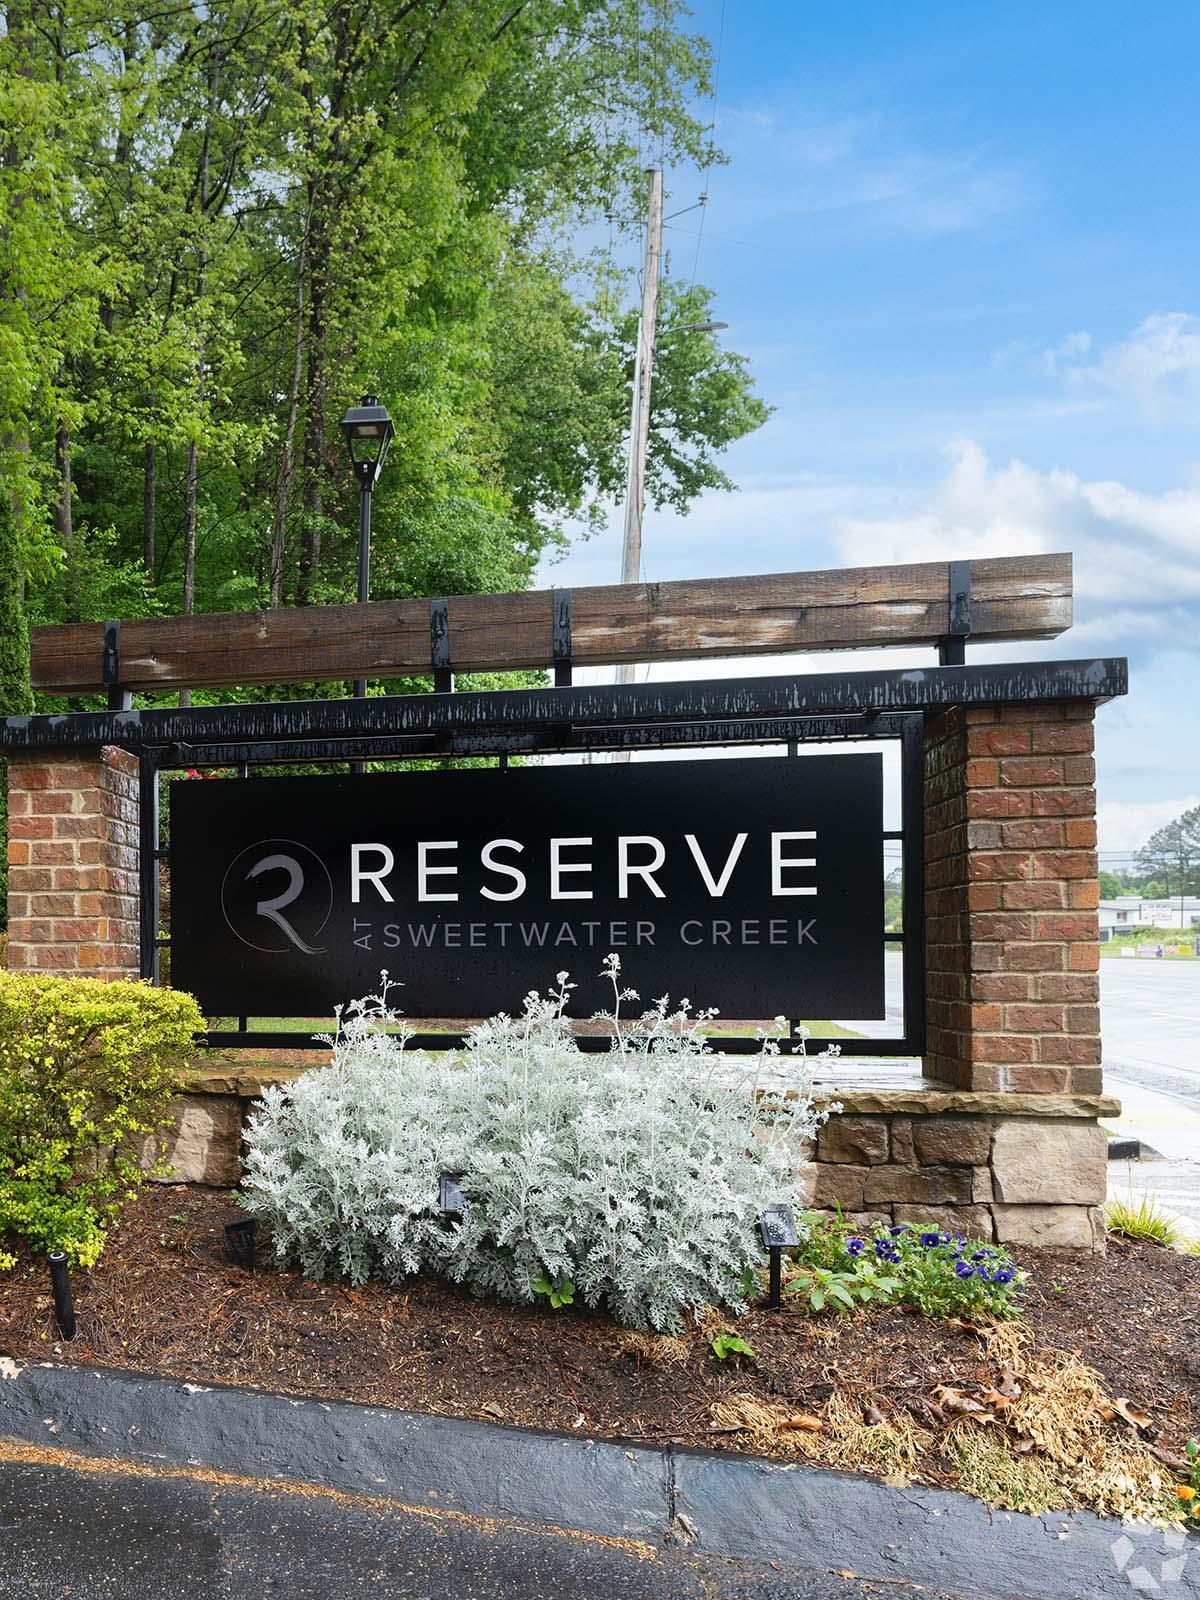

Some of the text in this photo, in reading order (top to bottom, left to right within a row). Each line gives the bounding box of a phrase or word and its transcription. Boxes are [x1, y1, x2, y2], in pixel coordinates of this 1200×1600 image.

[351, 831, 818, 903] RESERVE
[353, 917, 372, 950] AT
[383, 919, 819, 949] SWEETWATER CREEK
